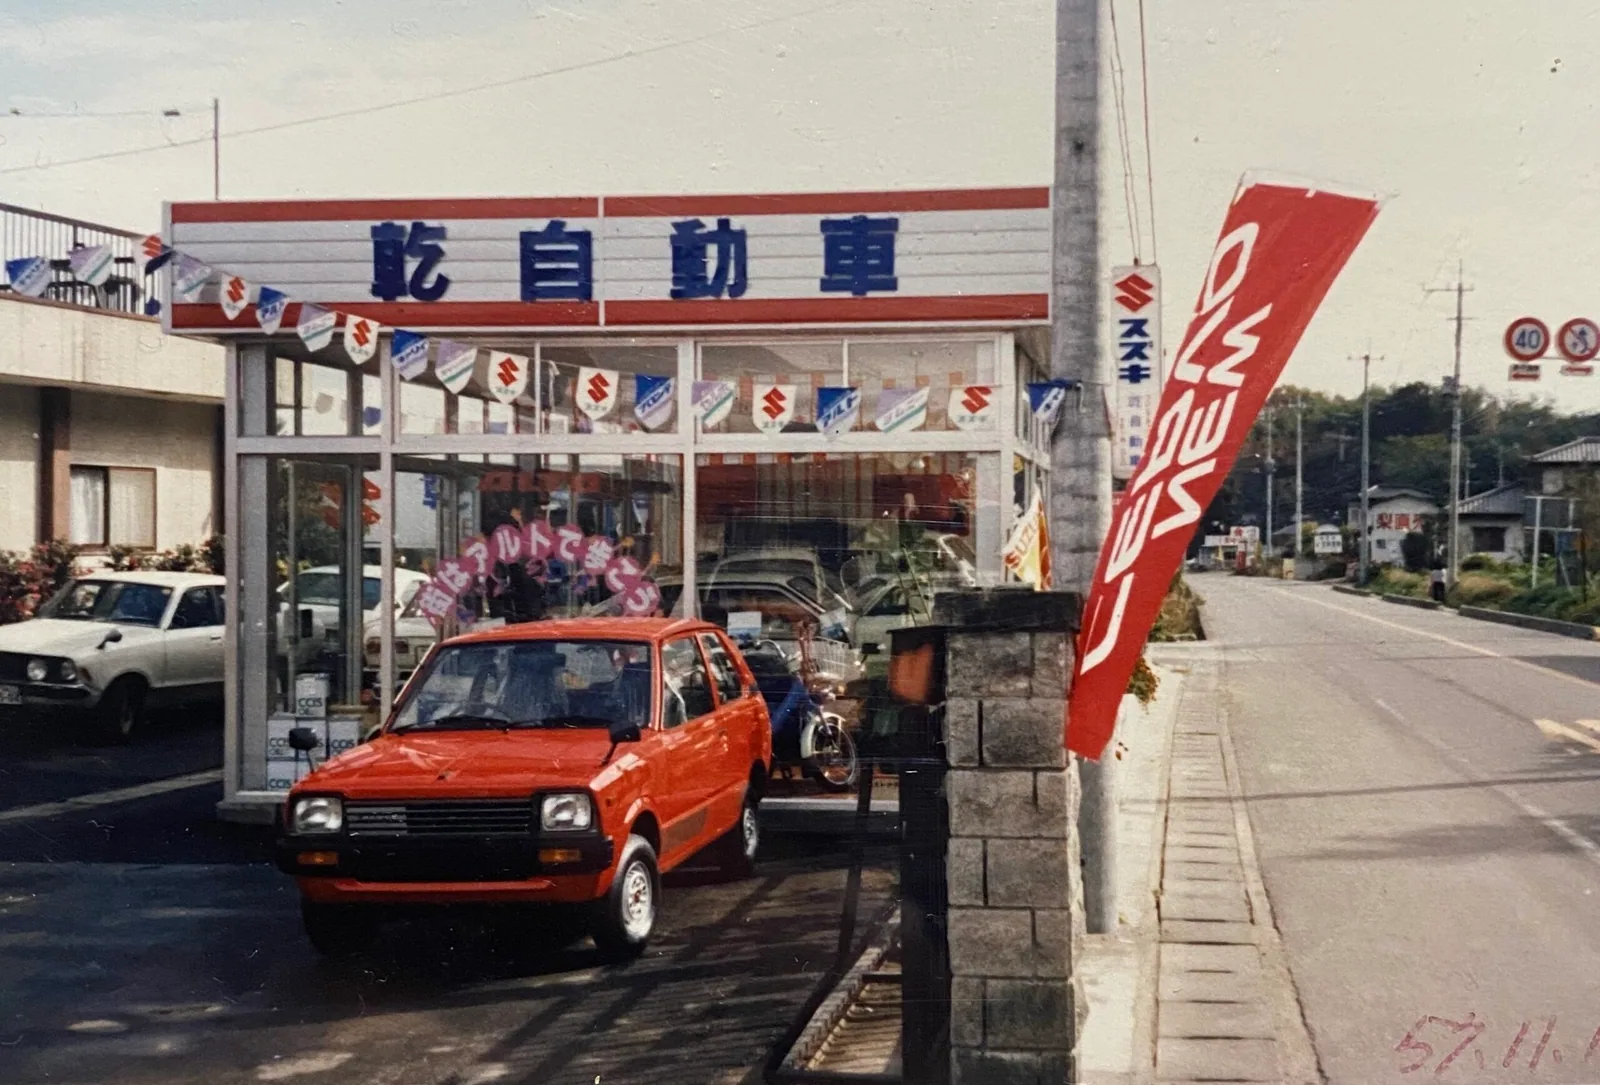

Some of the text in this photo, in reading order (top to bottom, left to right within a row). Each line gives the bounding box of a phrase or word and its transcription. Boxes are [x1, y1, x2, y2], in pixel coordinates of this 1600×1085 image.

[370, 217, 900, 303] 乾自動車
[1118, 318, 1154, 384] スズキ
[1515, 328, 1541, 350] 40
